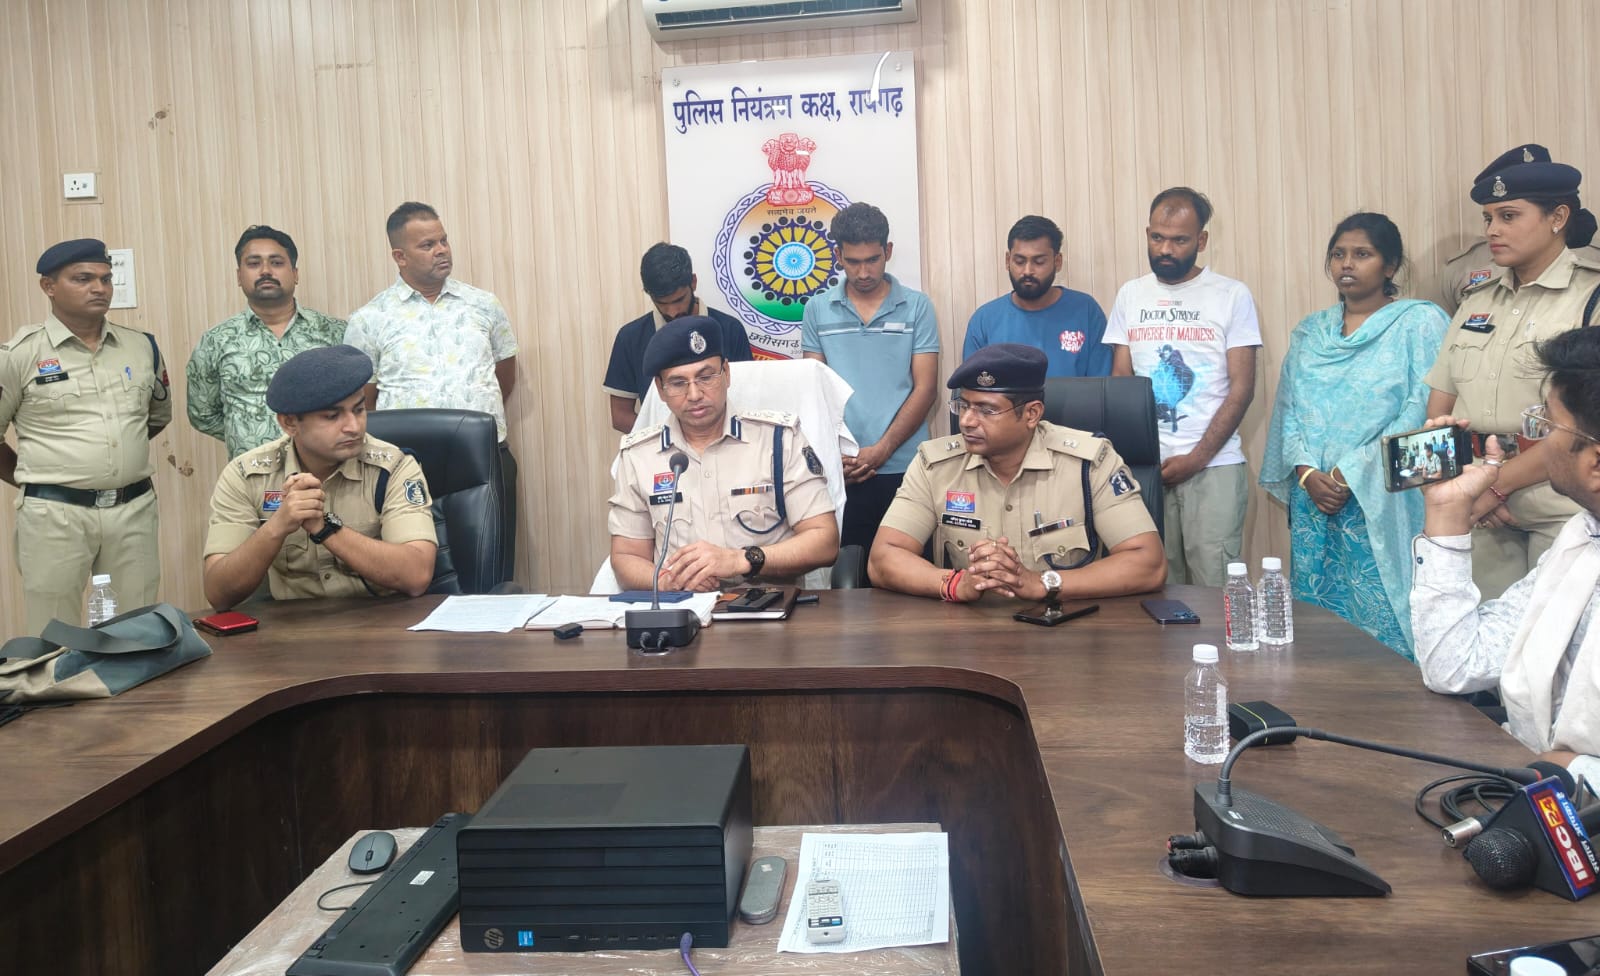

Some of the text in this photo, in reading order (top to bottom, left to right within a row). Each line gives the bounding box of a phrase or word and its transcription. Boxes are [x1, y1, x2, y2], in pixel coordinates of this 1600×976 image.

[673, 89, 724, 134] पुलिस
[800, 91, 841, 122] कक्ष,
[1165, 327, 1175, 340] OF
[1176, 327, 1215, 341] MADNESS
